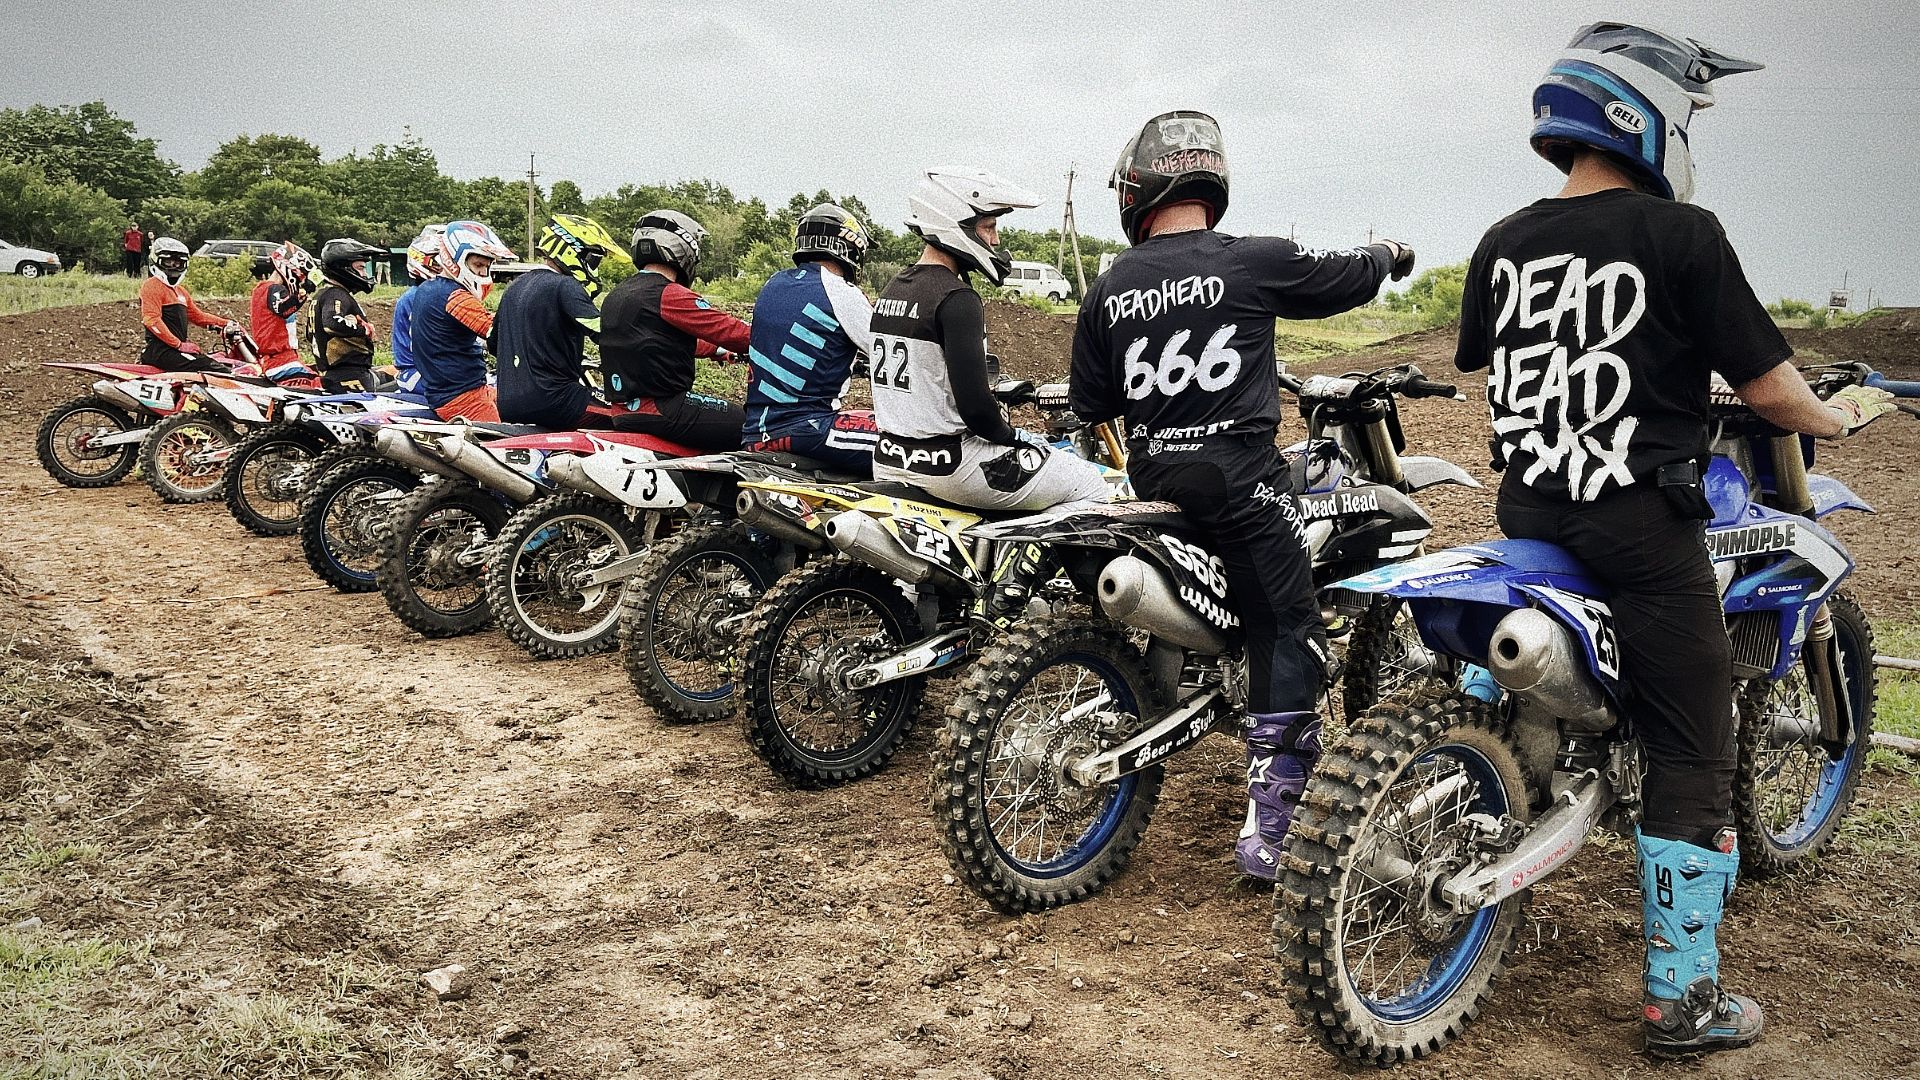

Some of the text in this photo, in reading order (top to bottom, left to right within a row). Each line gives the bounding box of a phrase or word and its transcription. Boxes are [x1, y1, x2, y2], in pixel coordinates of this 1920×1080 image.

[1612, 106, 1640, 129] BELL
[1104, 276, 1225, 329] DEADHEAD
[873, 336, 911, 391] 22
[1123, 323, 1242, 400] 666
[140, 383, 164, 401] 51
[823, 486, 860, 499] SUZUKI
[906, 504, 942, 517] SUZUKI
[1300, 488, 1380, 520] Dead Head
[915, 523, 953, 565] 22
[1159, 533, 1229, 599] 666
[1767, 584, 1803, 593] SALMONICA
[1134, 708, 1216, 768] Beer and Style
[1526, 840, 1573, 877] SALMONICA
